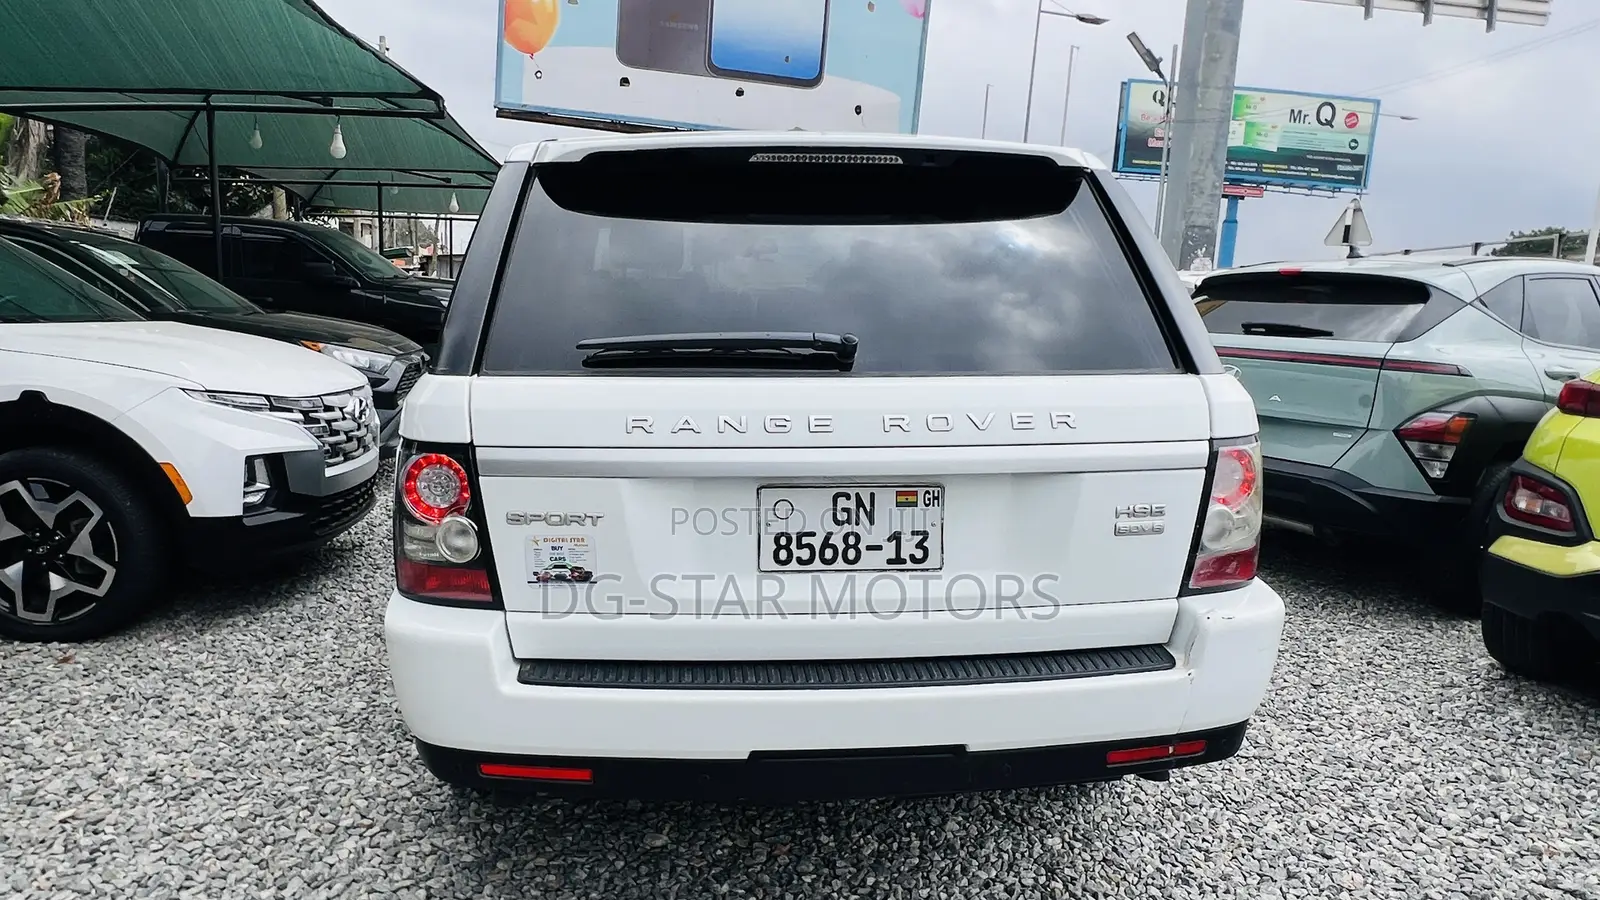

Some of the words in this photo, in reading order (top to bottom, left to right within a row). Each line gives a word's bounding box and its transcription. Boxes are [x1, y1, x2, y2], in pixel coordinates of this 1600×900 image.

[1289, 109, 1311, 125] Mr.
[1316, 101, 1336, 129] Q
[625, 414, 834, 435] RANGE
[882, 411, 1078, 433] ROVER
[832, 492, 875, 526] GN
[923, 490, 940, 507] GH
[506, 509, 605, 527] SPORT
[1115, 503, 1167, 519] HSE
[773, 530, 930, 566] 8568-13
